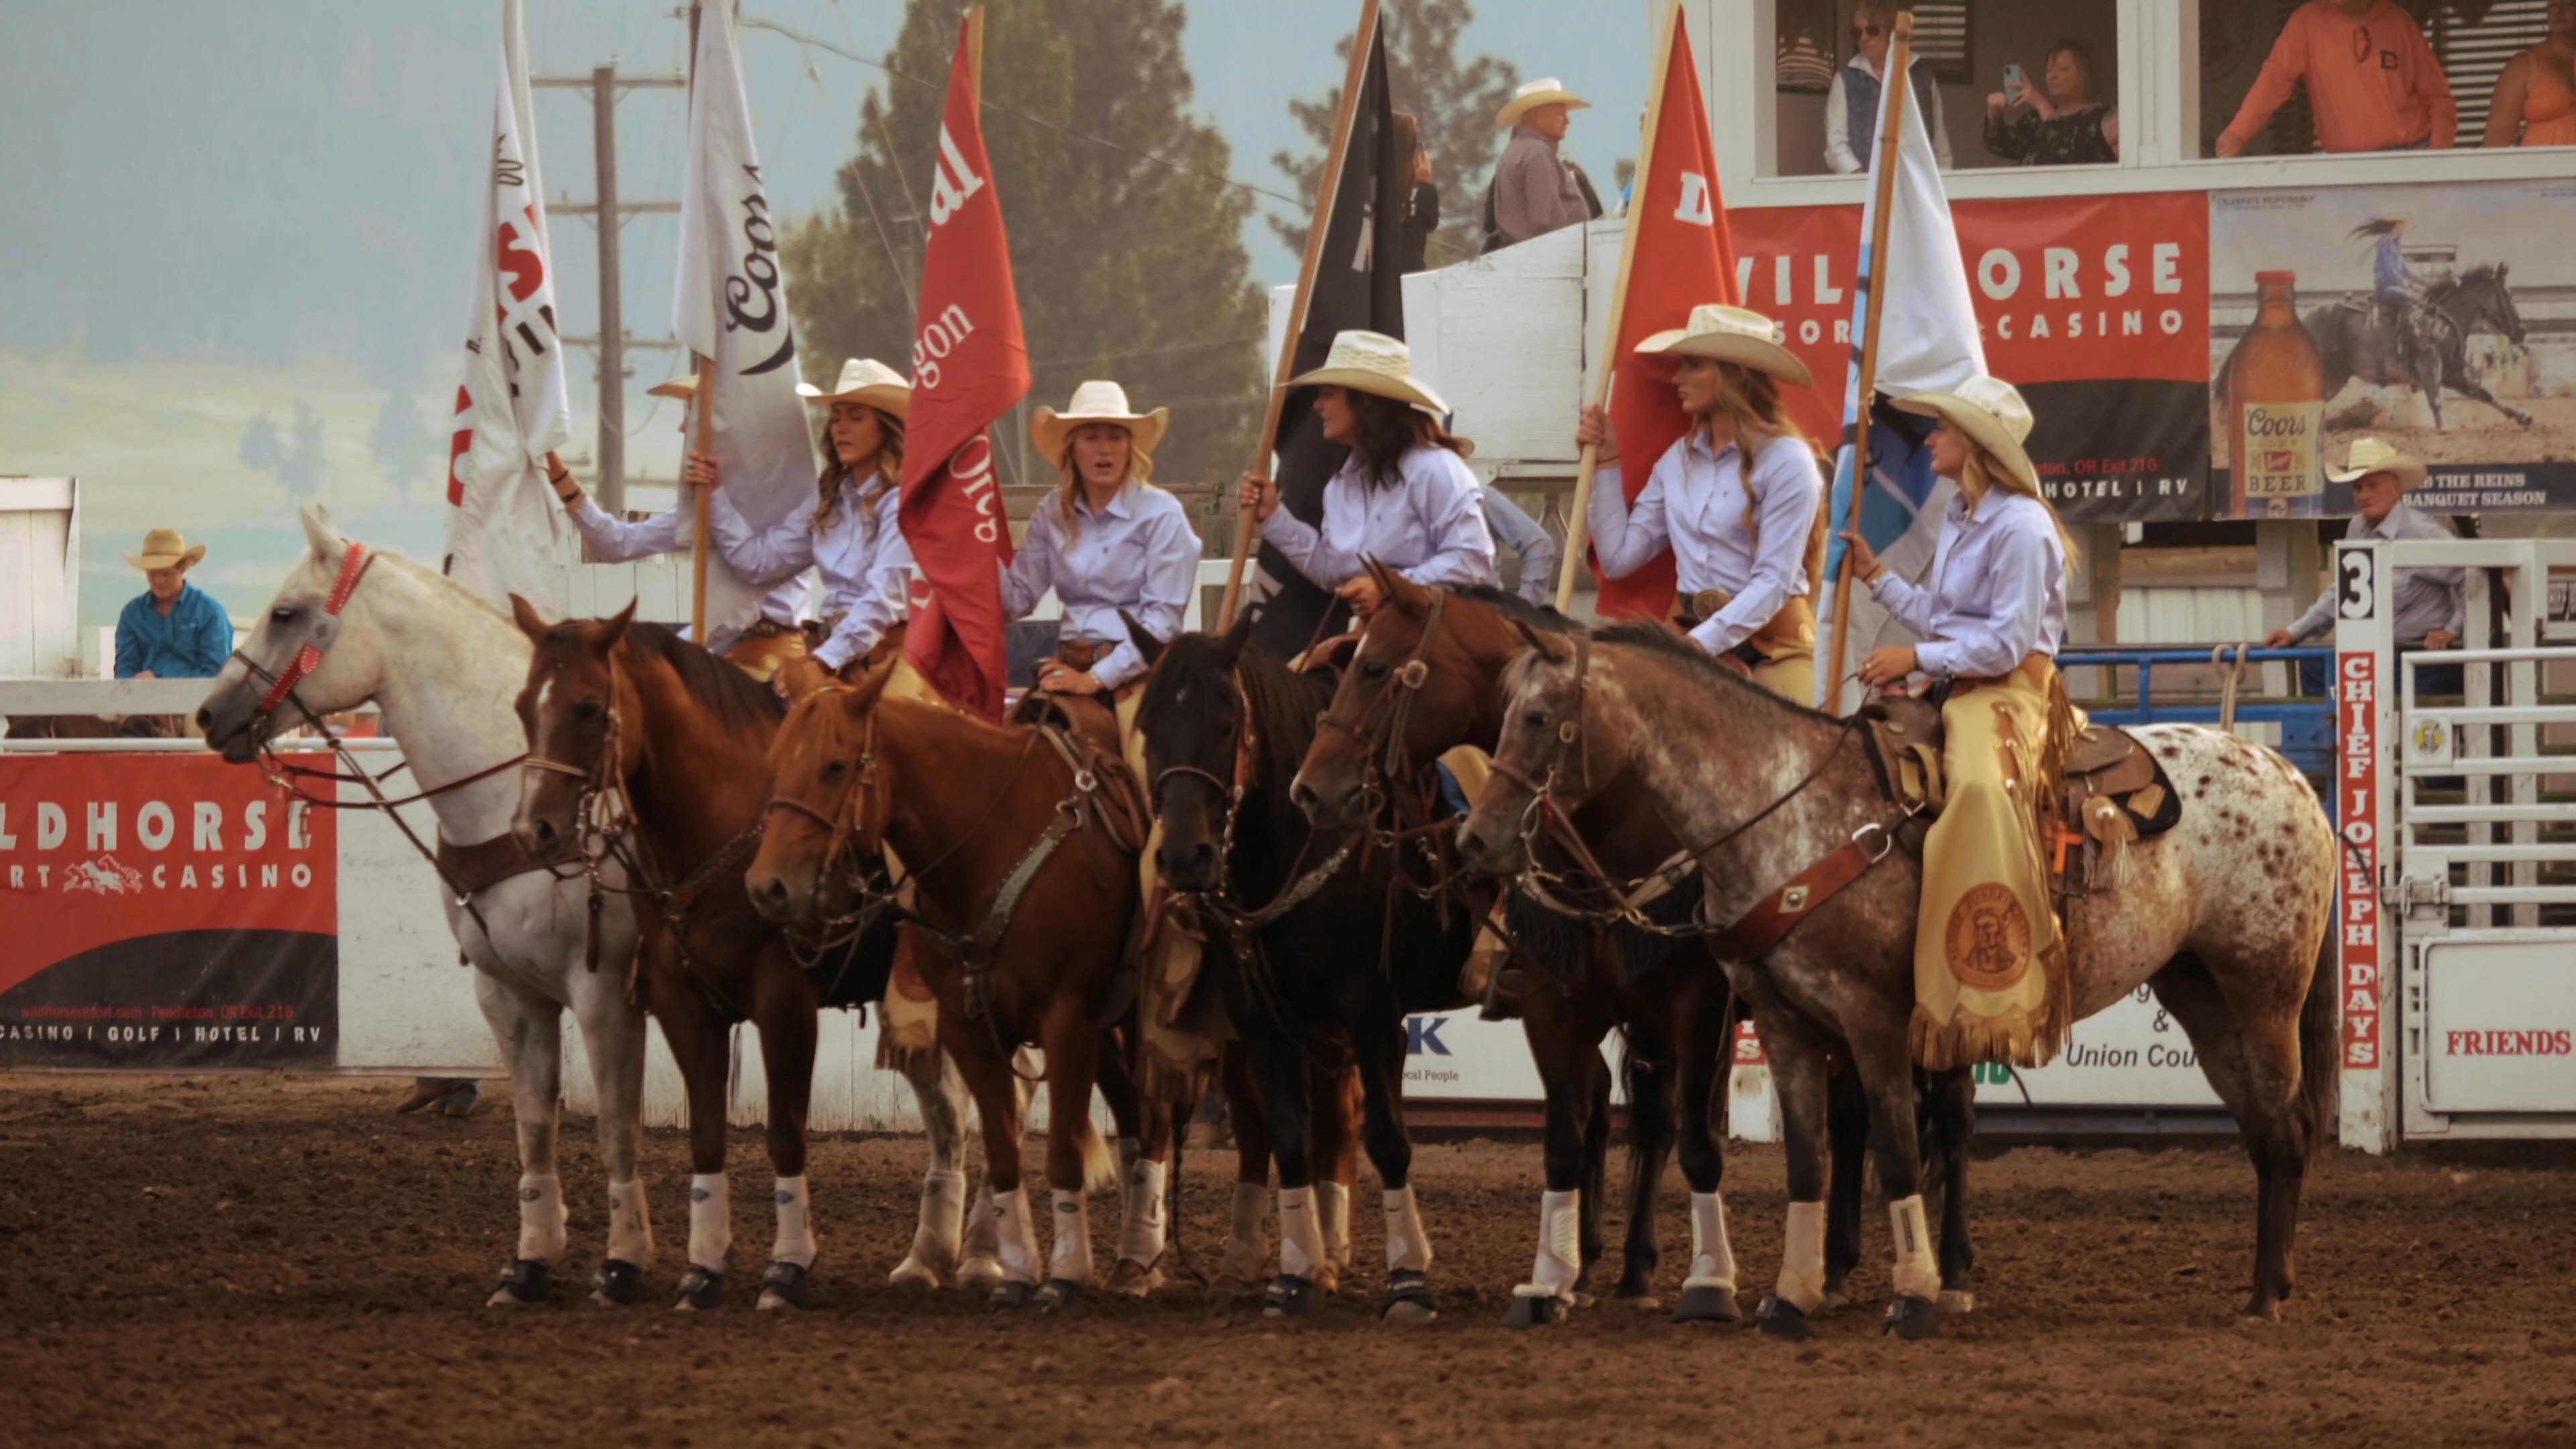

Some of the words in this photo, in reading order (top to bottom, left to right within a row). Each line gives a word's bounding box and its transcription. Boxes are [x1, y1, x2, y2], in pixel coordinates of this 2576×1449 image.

[1996, 309, 2183, 339] CASINO
[2247, 407, 2306, 437] Coors
[2074, 459, 2097, 474] OR
[2102, 459, 2127, 473] Exit
[2130, 457, 2157, 472] 216
[2044, 480, 2122, 498] HOTEL
[2158, 477, 2188, 496] RV
[2248, 476, 2306, 492] BEER
[2434, 474, 2471, 488] THE
[2474, 472, 2526, 488] REINS
[2401, 492, 2479, 507] BANQUET
[2481, 490, 2546, 506] SEASON
[2341, 549, 2373, 620] 3
[2344, 656, 2373, 779] CHIEF
[152, 863, 311, 889] CASINO
[2345, 790, 2373, 946] JOSEPH
[152, 1005, 214, 1020] Pendleton,
[240, 1006, 262, 1018] Exit
[268, 1005, 294, 1018] 216
[2348, 963, 2375, 1065] DAYS
[107, 1026, 160, 1042] GOLF
[195, 1026, 260, 1041] HOTEL
[294, 1027, 320, 1041] RV
[2447, 1030, 2572, 1056] FRIENDS
[2065, 1043, 2138, 1068] Union
[1424, 1069, 1459, 1083] People
